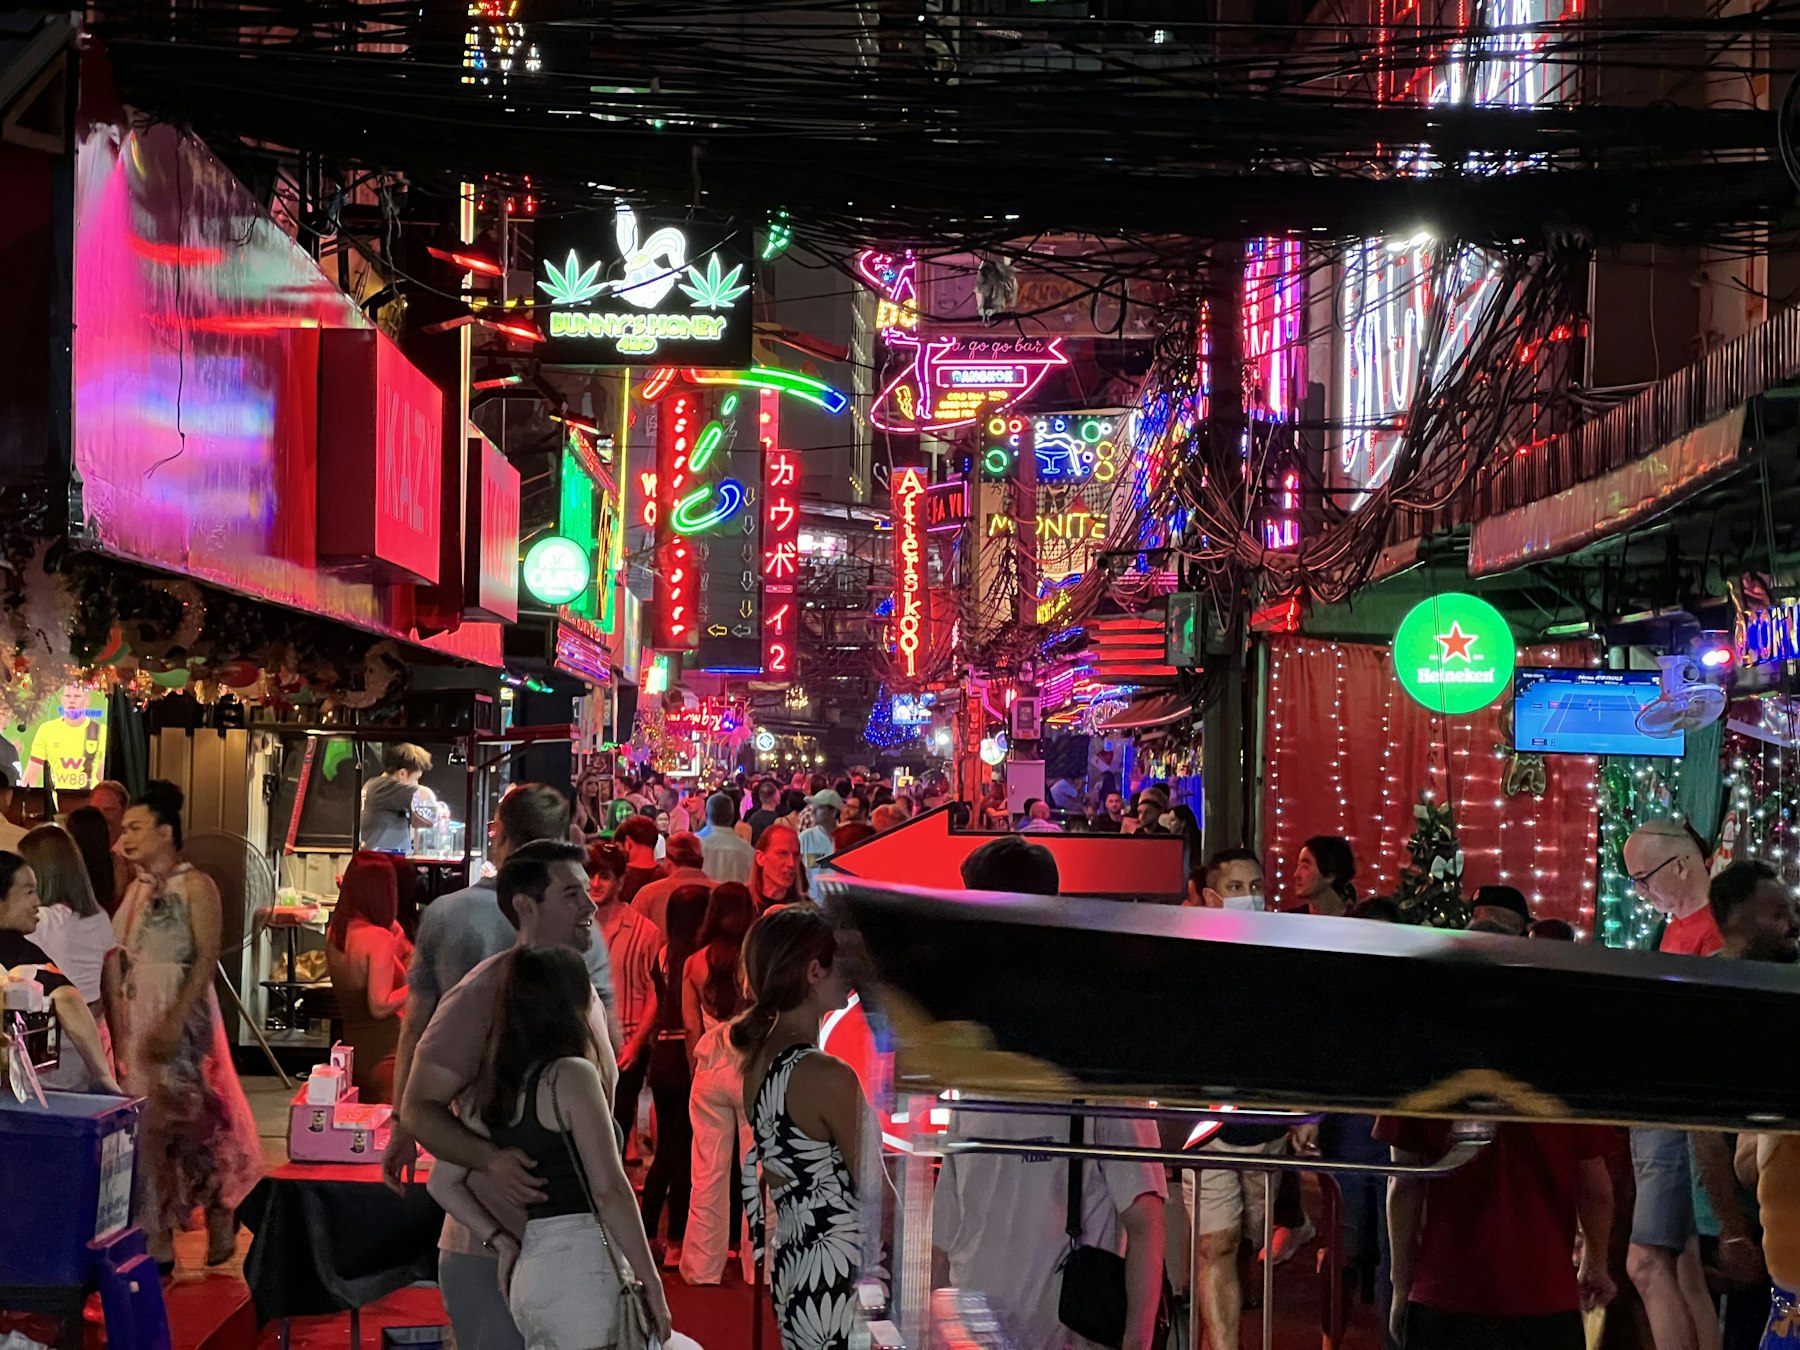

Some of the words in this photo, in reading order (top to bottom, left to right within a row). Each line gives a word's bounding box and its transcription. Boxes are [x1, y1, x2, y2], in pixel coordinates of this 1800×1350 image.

[550, 312, 645, 337] BUNNY'S
[649, 313, 727, 340] HONEY
[616, 336, 657, 354] 420
[969, 340, 989, 359] go
[992, 341, 1012, 359] go
[1015, 338, 1044, 352] bar
[383, 383, 437, 539] KAZY
[988, 513, 1108, 539] MNITE
[765, 453, 796, 672] カウボーイ2
[1417, 667, 1495, 683] Heineken
[57, 773, 87, 785] W88
